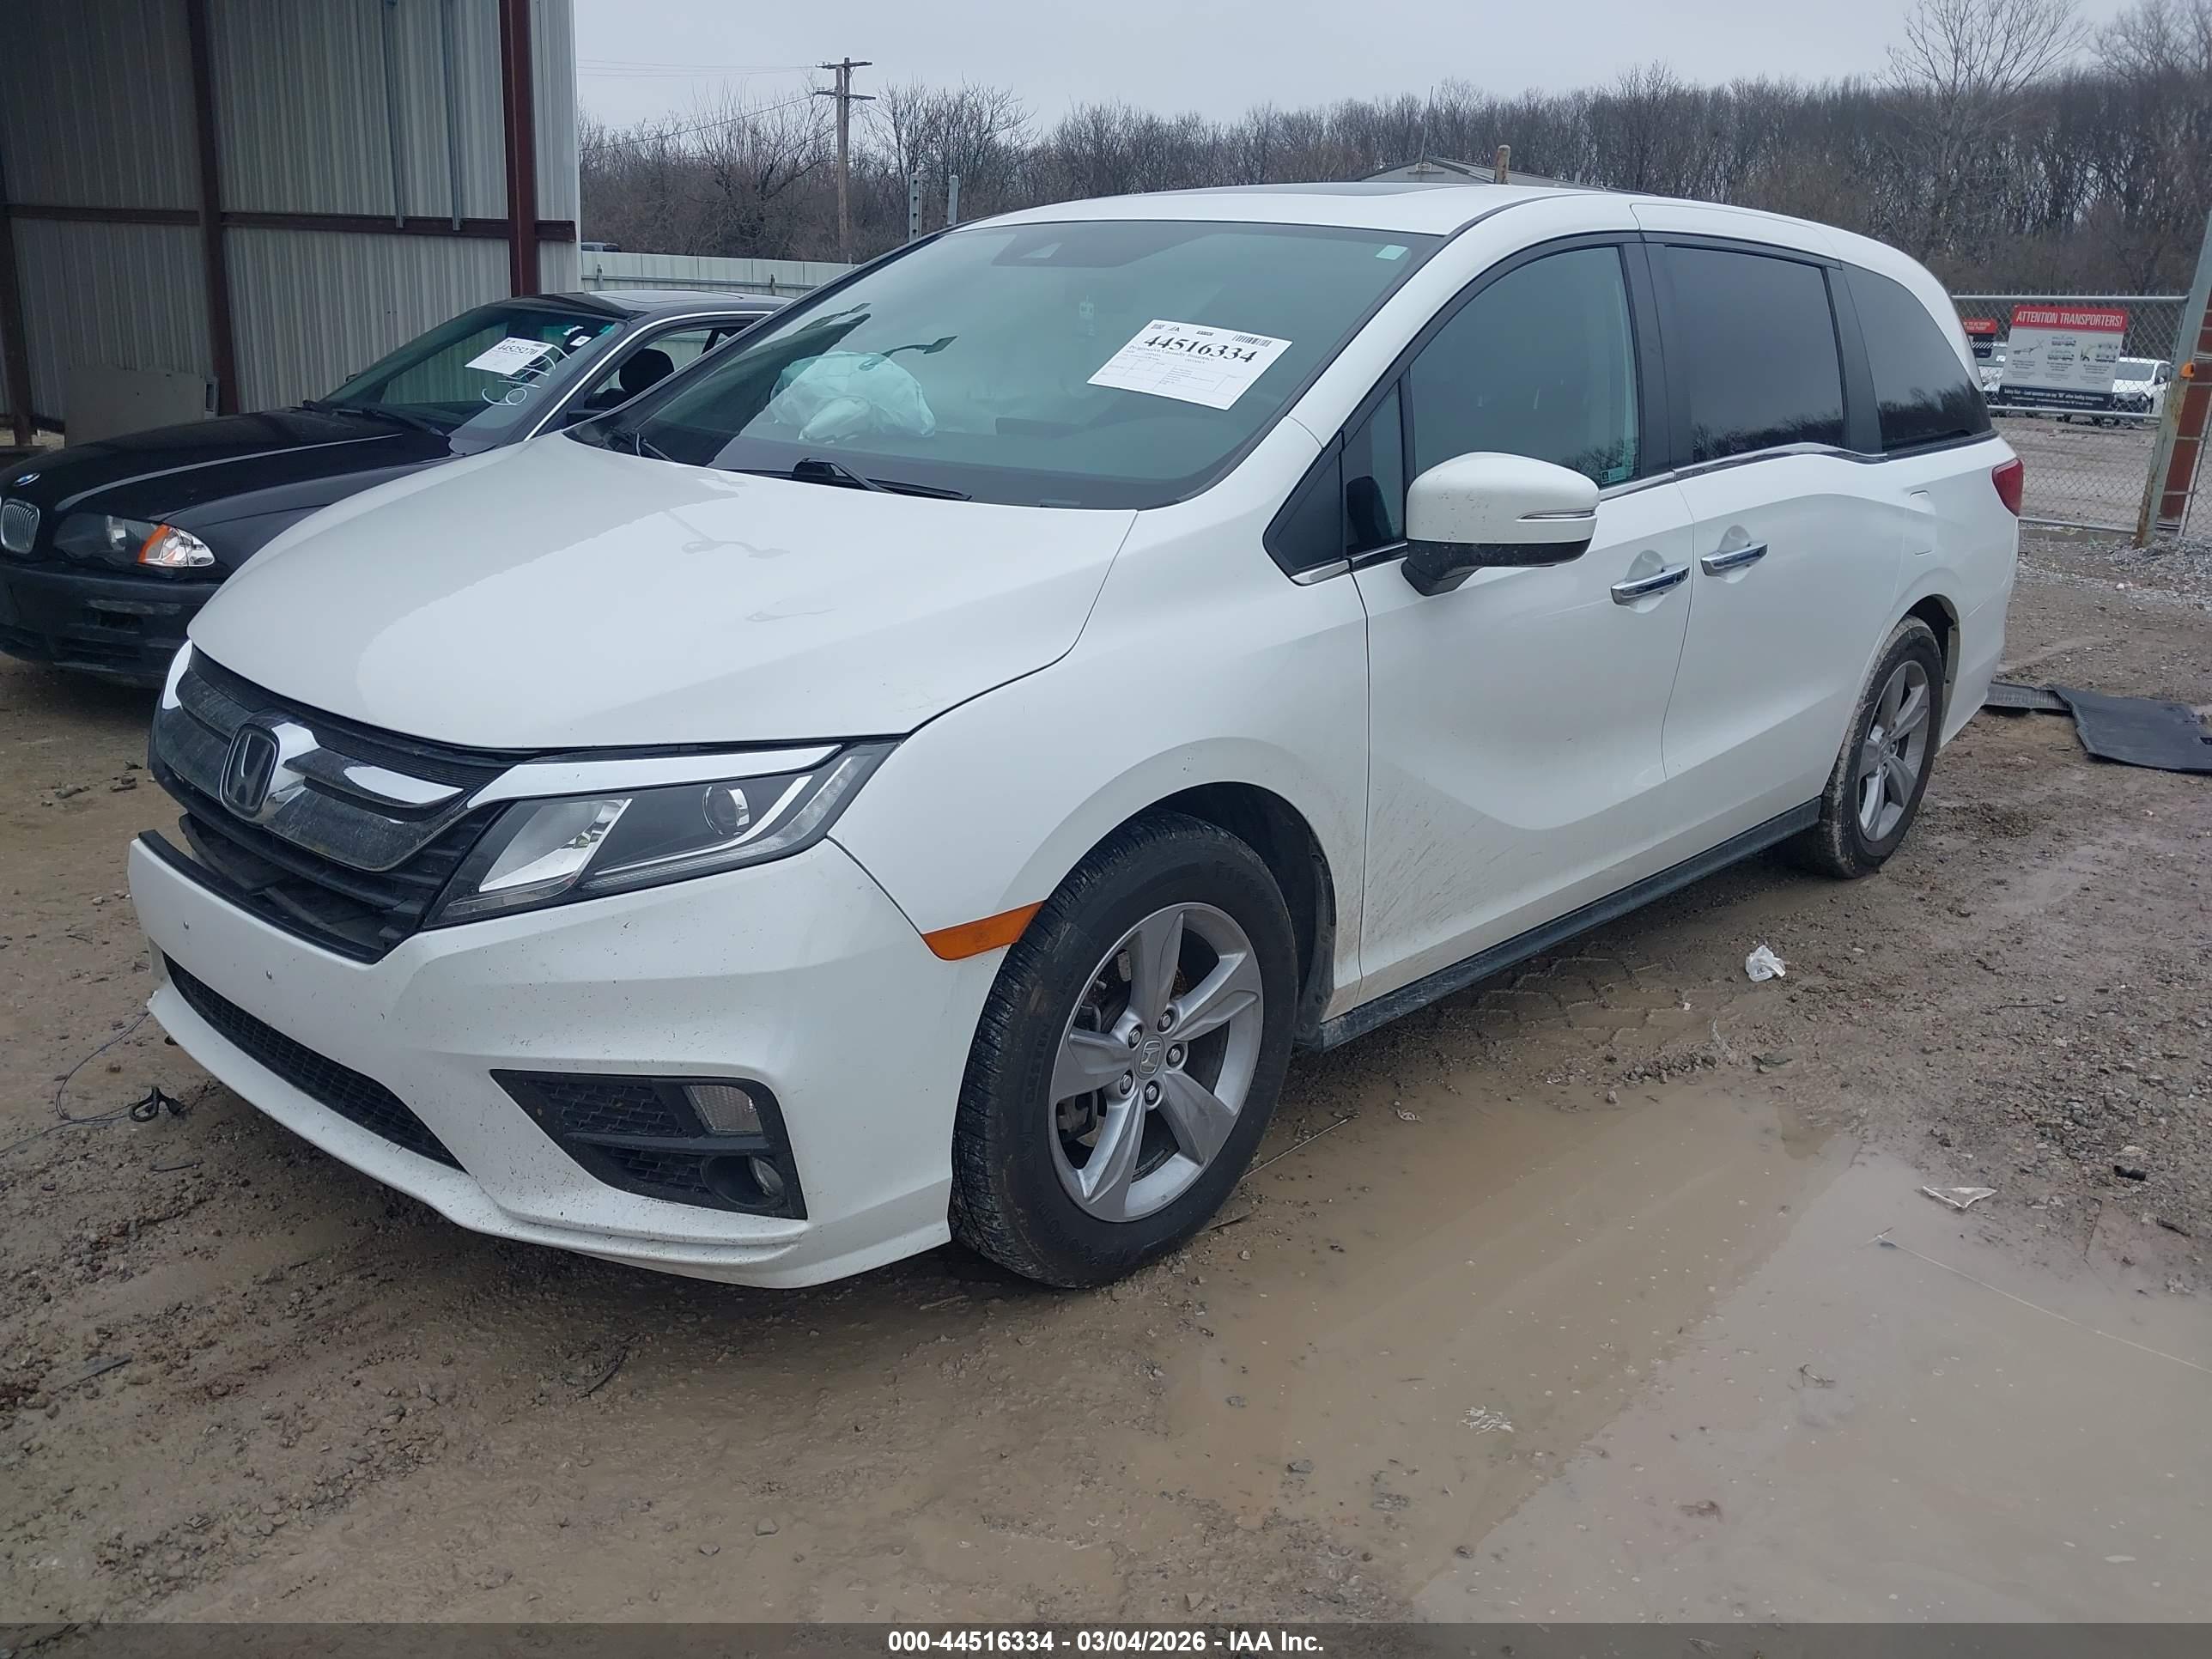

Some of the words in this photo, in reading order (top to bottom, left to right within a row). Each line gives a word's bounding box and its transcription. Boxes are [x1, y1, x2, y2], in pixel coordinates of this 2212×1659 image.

[2016, 311, 2058, 324] ATTENTION
[2060, 313, 2123, 327] TRANSPORTERS!
[1144, 335, 1258, 364] 44516334
